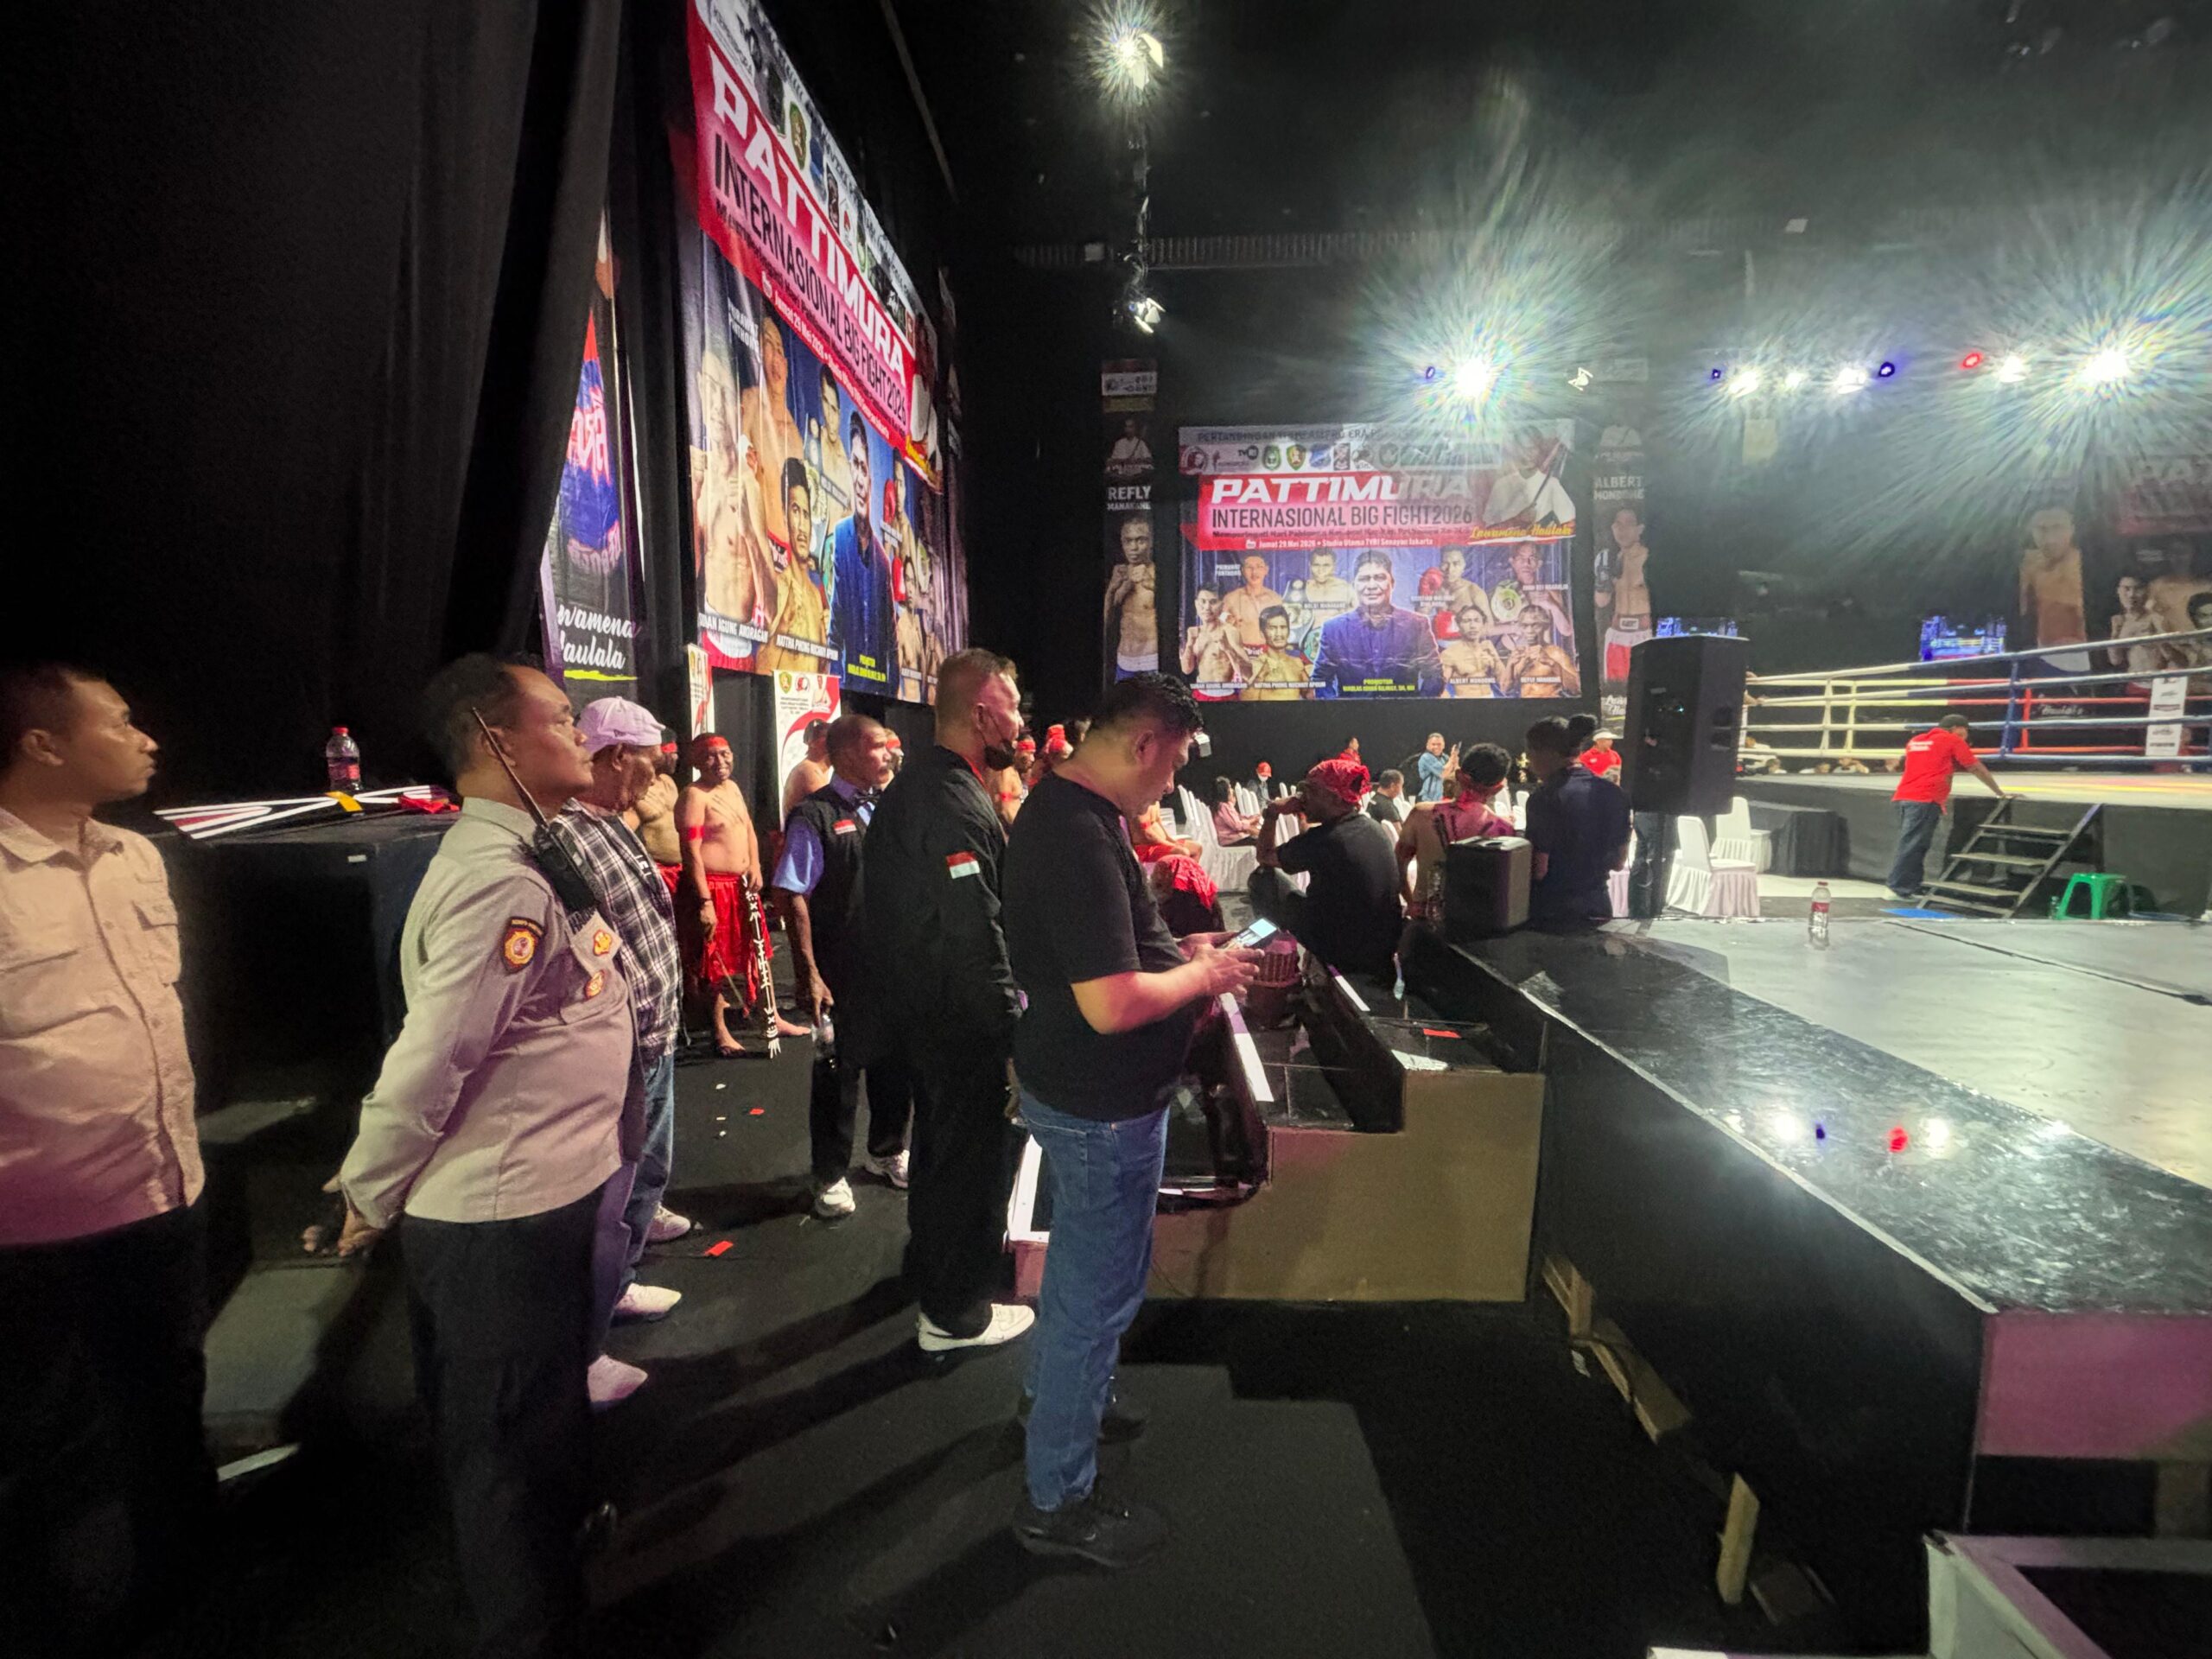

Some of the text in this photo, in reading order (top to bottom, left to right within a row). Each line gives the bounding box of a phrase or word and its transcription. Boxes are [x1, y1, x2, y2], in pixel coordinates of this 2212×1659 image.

[708, 43, 906, 389] PATTIMURA
[715, 132, 842, 343] INTERNASIONAL
[844, 314, 860, 366] BIG
[1107, 486, 1152, 500] REFLY
[1211, 475, 1472, 504] PATTIMURA
[1594, 476, 1642, 488] ALBERT
[1212, 506, 1346, 529] INTERNASIONAL
[1351, 505, 1379, 526] BIG
[1381, 537, 1408, 547] Senayan
[557, 604, 641, 639] wamena
[560, 631, 626, 670] aulala
